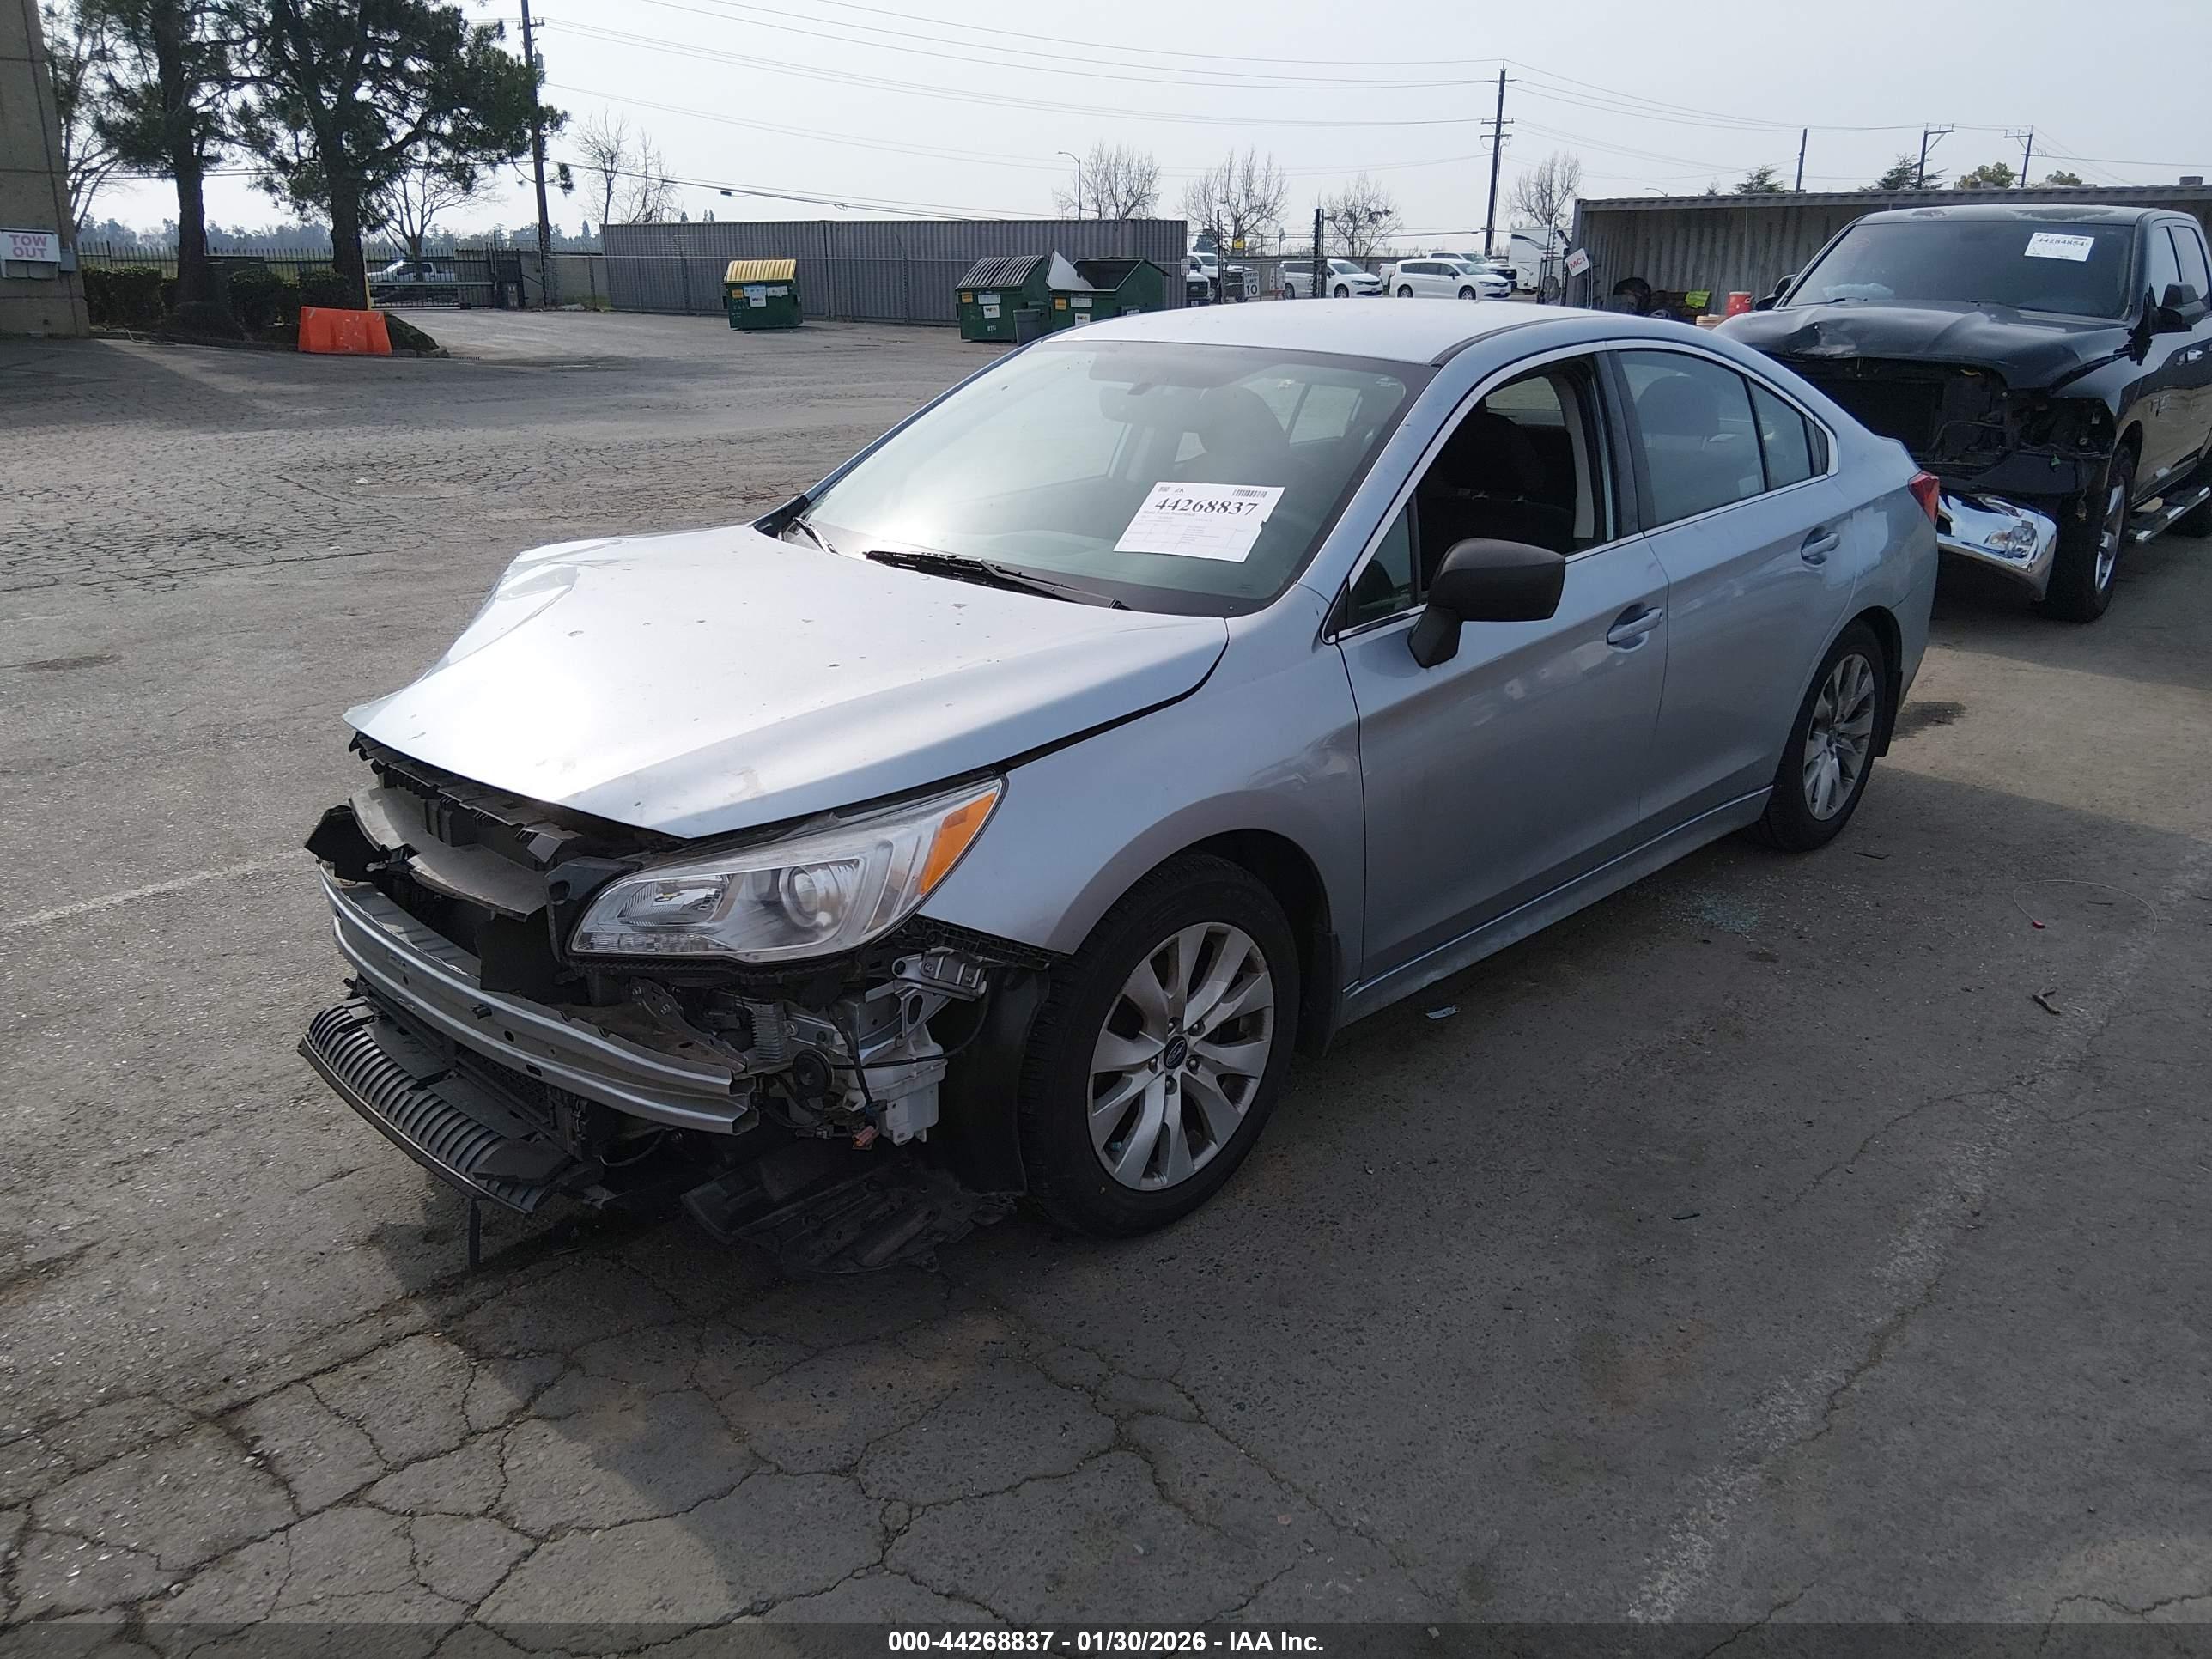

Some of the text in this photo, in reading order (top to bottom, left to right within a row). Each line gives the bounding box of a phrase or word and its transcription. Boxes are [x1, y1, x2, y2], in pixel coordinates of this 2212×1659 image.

[9, 234, 47, 247] TOW
[13, 246, 47, 258] OUT
[1570, 256, 1586, 270] MC1
[1246, 284, 1258, 295] 10
[1155, 497, 1258, 516] 44268837
